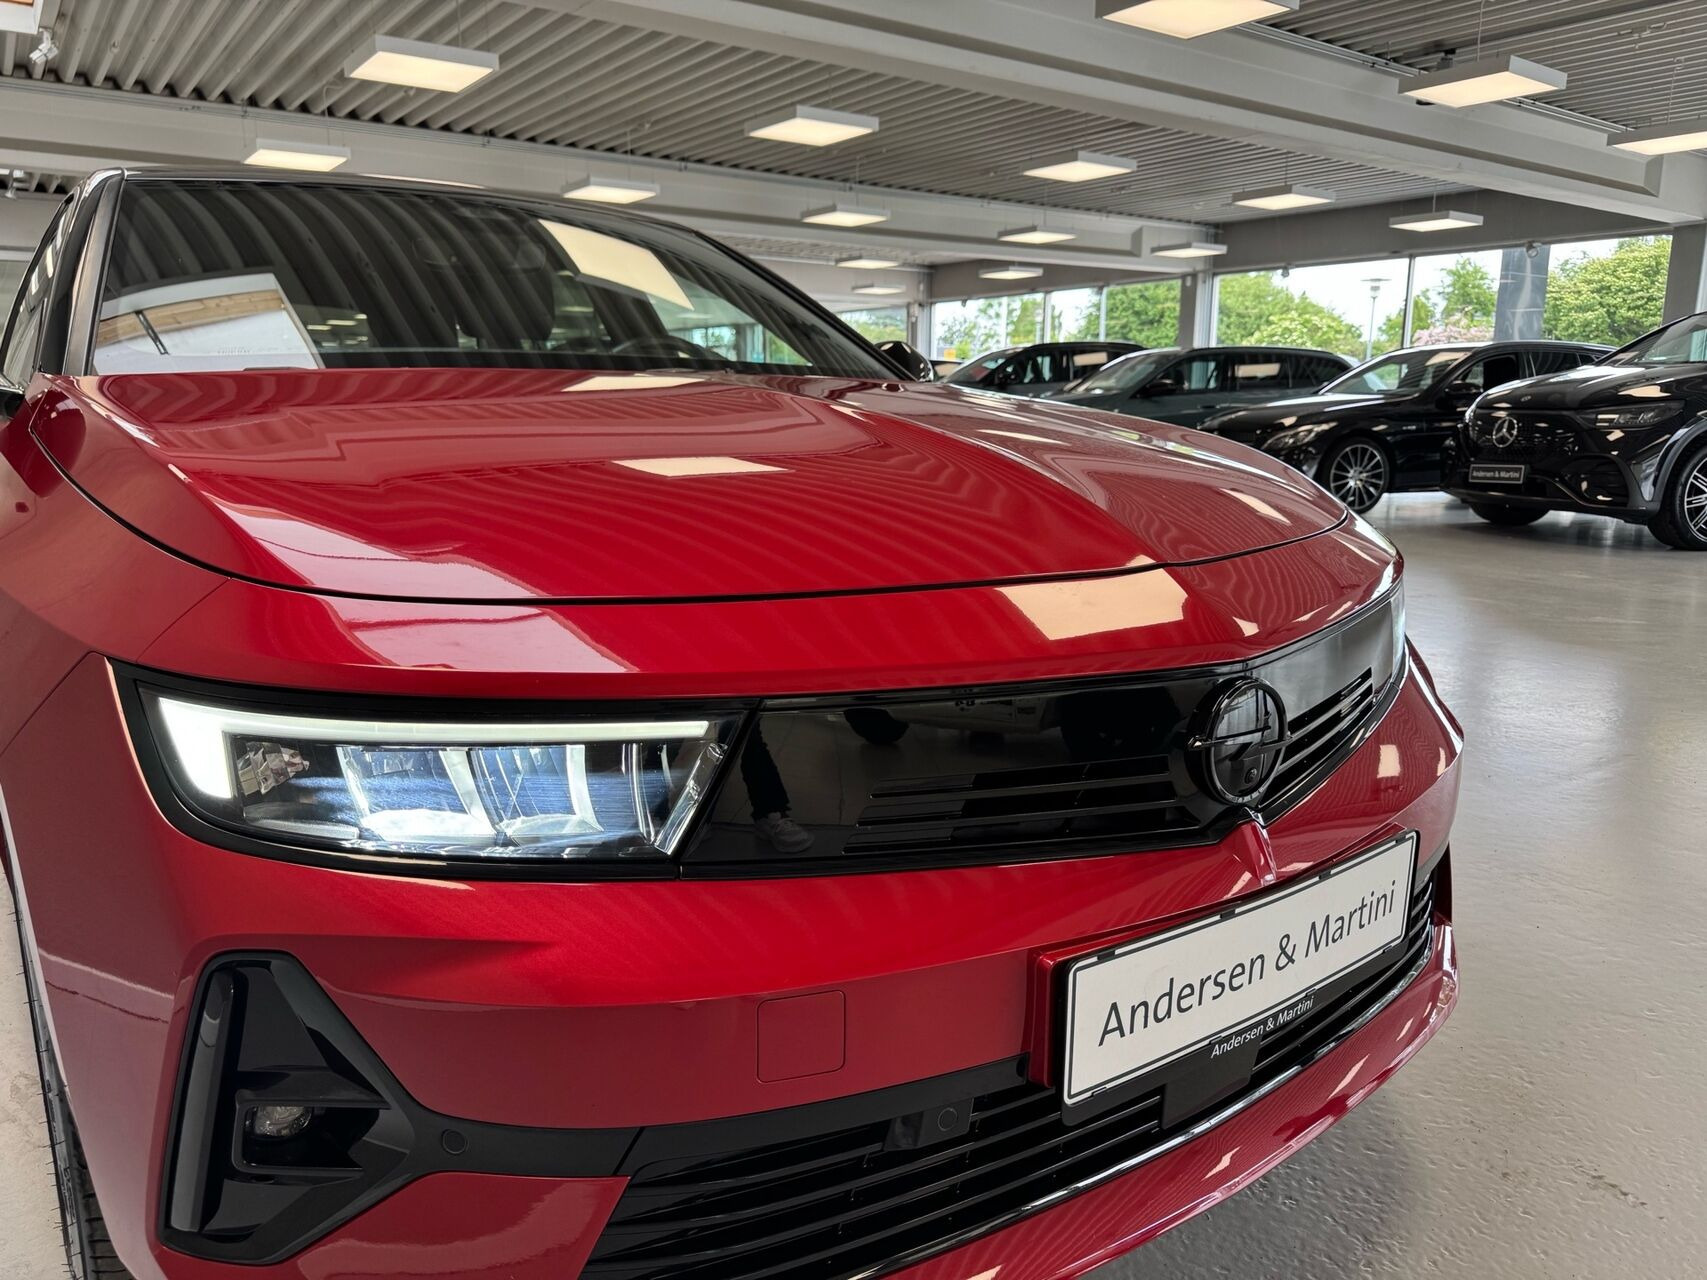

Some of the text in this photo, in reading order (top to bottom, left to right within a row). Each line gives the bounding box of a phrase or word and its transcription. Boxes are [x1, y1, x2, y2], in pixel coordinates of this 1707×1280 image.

[1098, 879, 1396, 1047] Andersen & Martini
[1210, 995, 1315, 1059] Andersen & Martini
